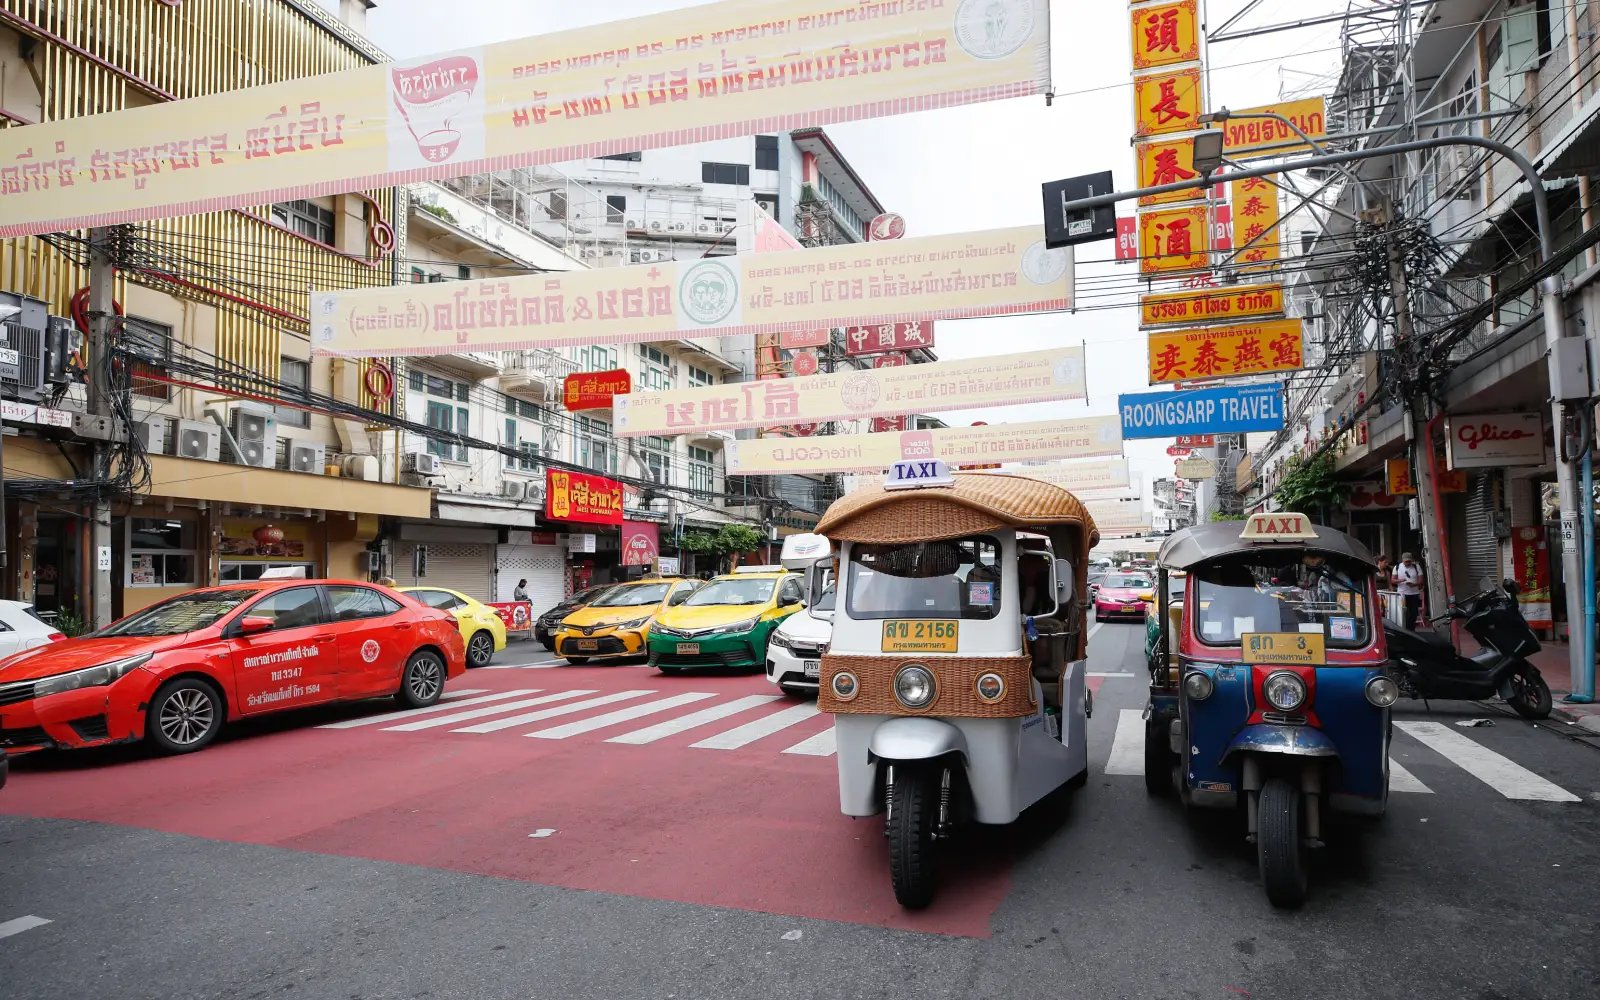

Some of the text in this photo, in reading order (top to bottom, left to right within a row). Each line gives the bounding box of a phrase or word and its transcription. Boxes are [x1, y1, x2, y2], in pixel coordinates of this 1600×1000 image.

[851, 321, 925, 351] 中國城
[1124, 395, 1279, 428] ROONGSARP TRAVEL
[895, 462, 937, 480] TAXI
[1253, 517, 1302, 534] TAXI
[886, 622, 955, 638] สข 2156
